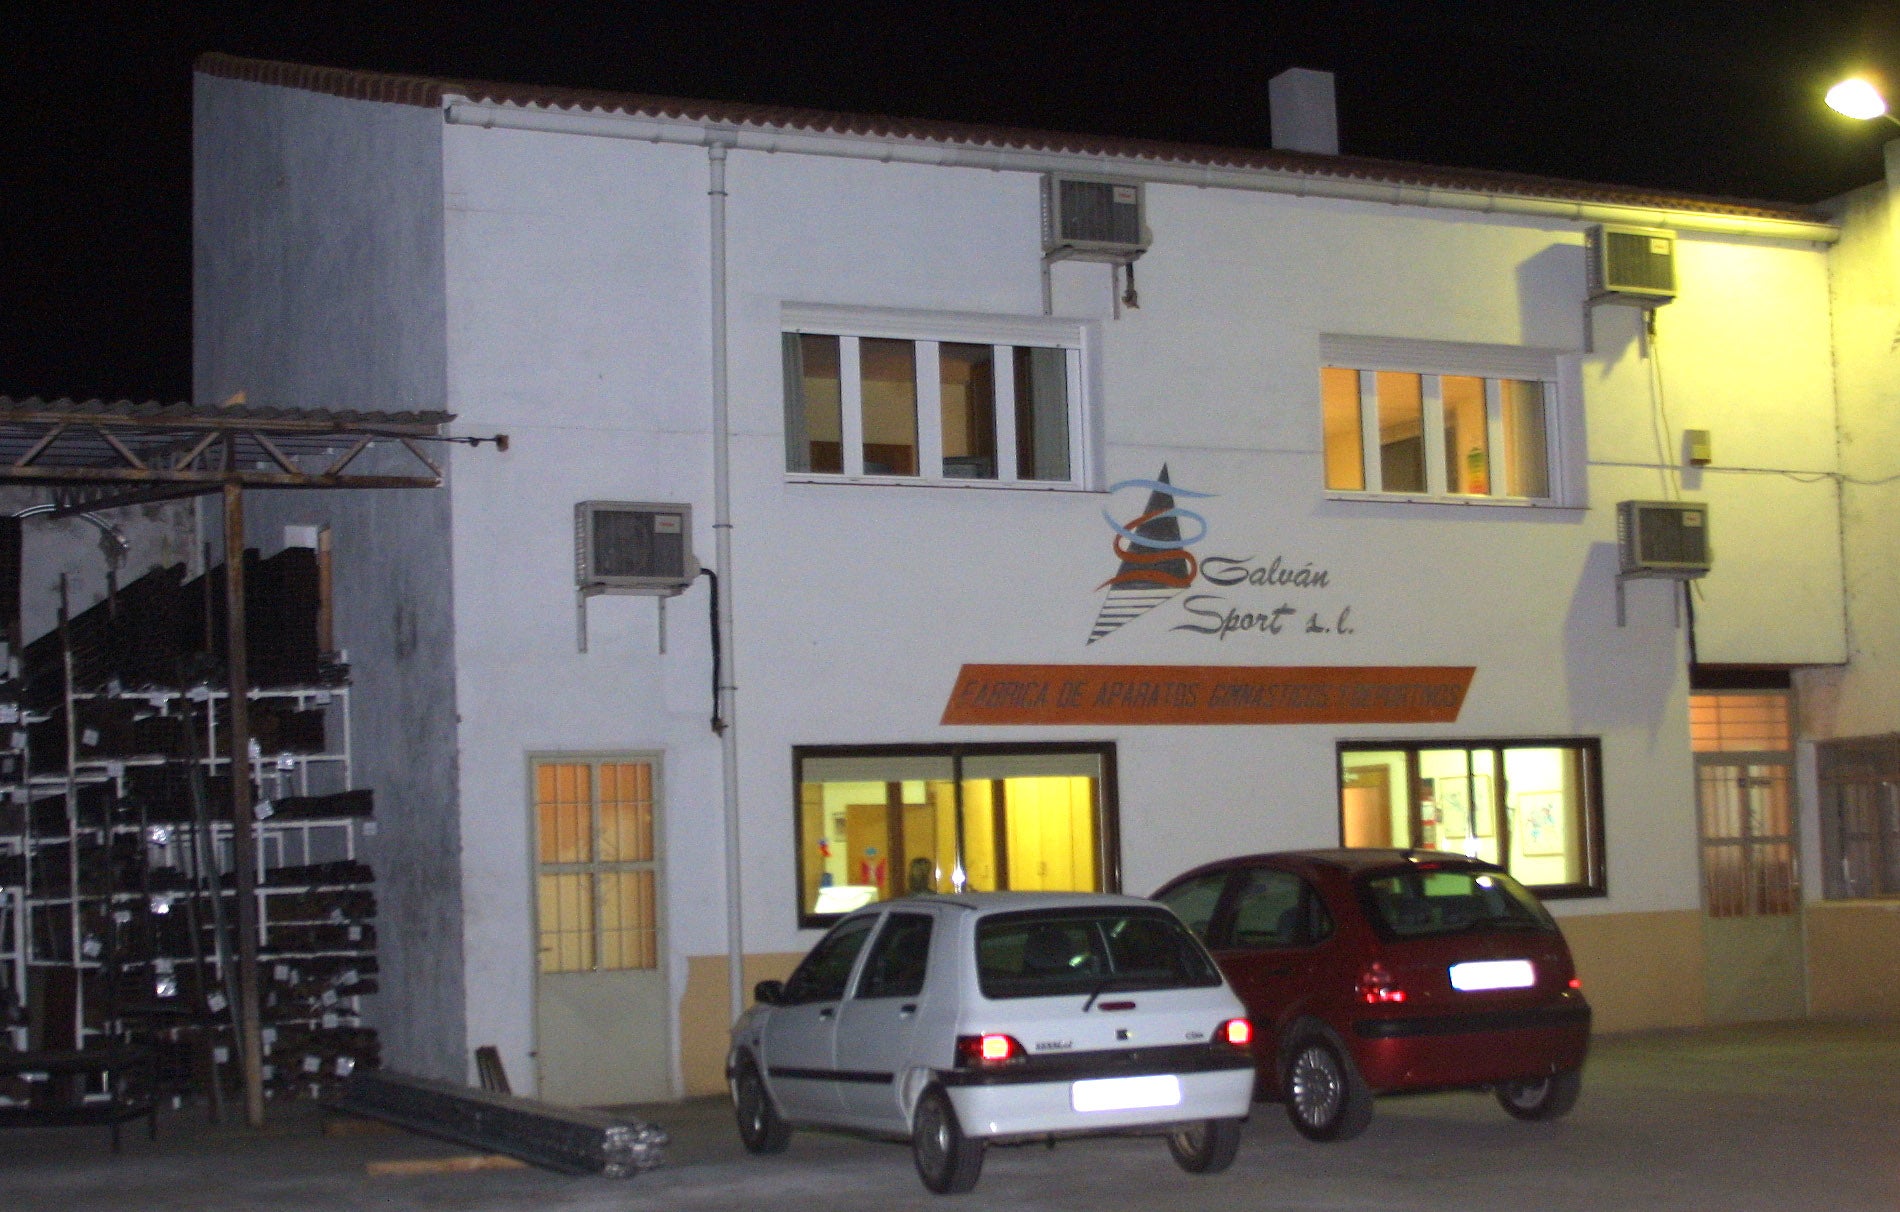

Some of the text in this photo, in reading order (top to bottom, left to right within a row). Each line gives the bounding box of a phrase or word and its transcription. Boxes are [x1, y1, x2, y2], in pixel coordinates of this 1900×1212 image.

[1200, 555, 1330, 588] Galván
[1169, 594, 1296, 640] Sport
[958, 680, 1049, 708] FABRICA
[1056, 681, 1088, 708] DE
[1093, 681, 1201, 708] APARATOS
